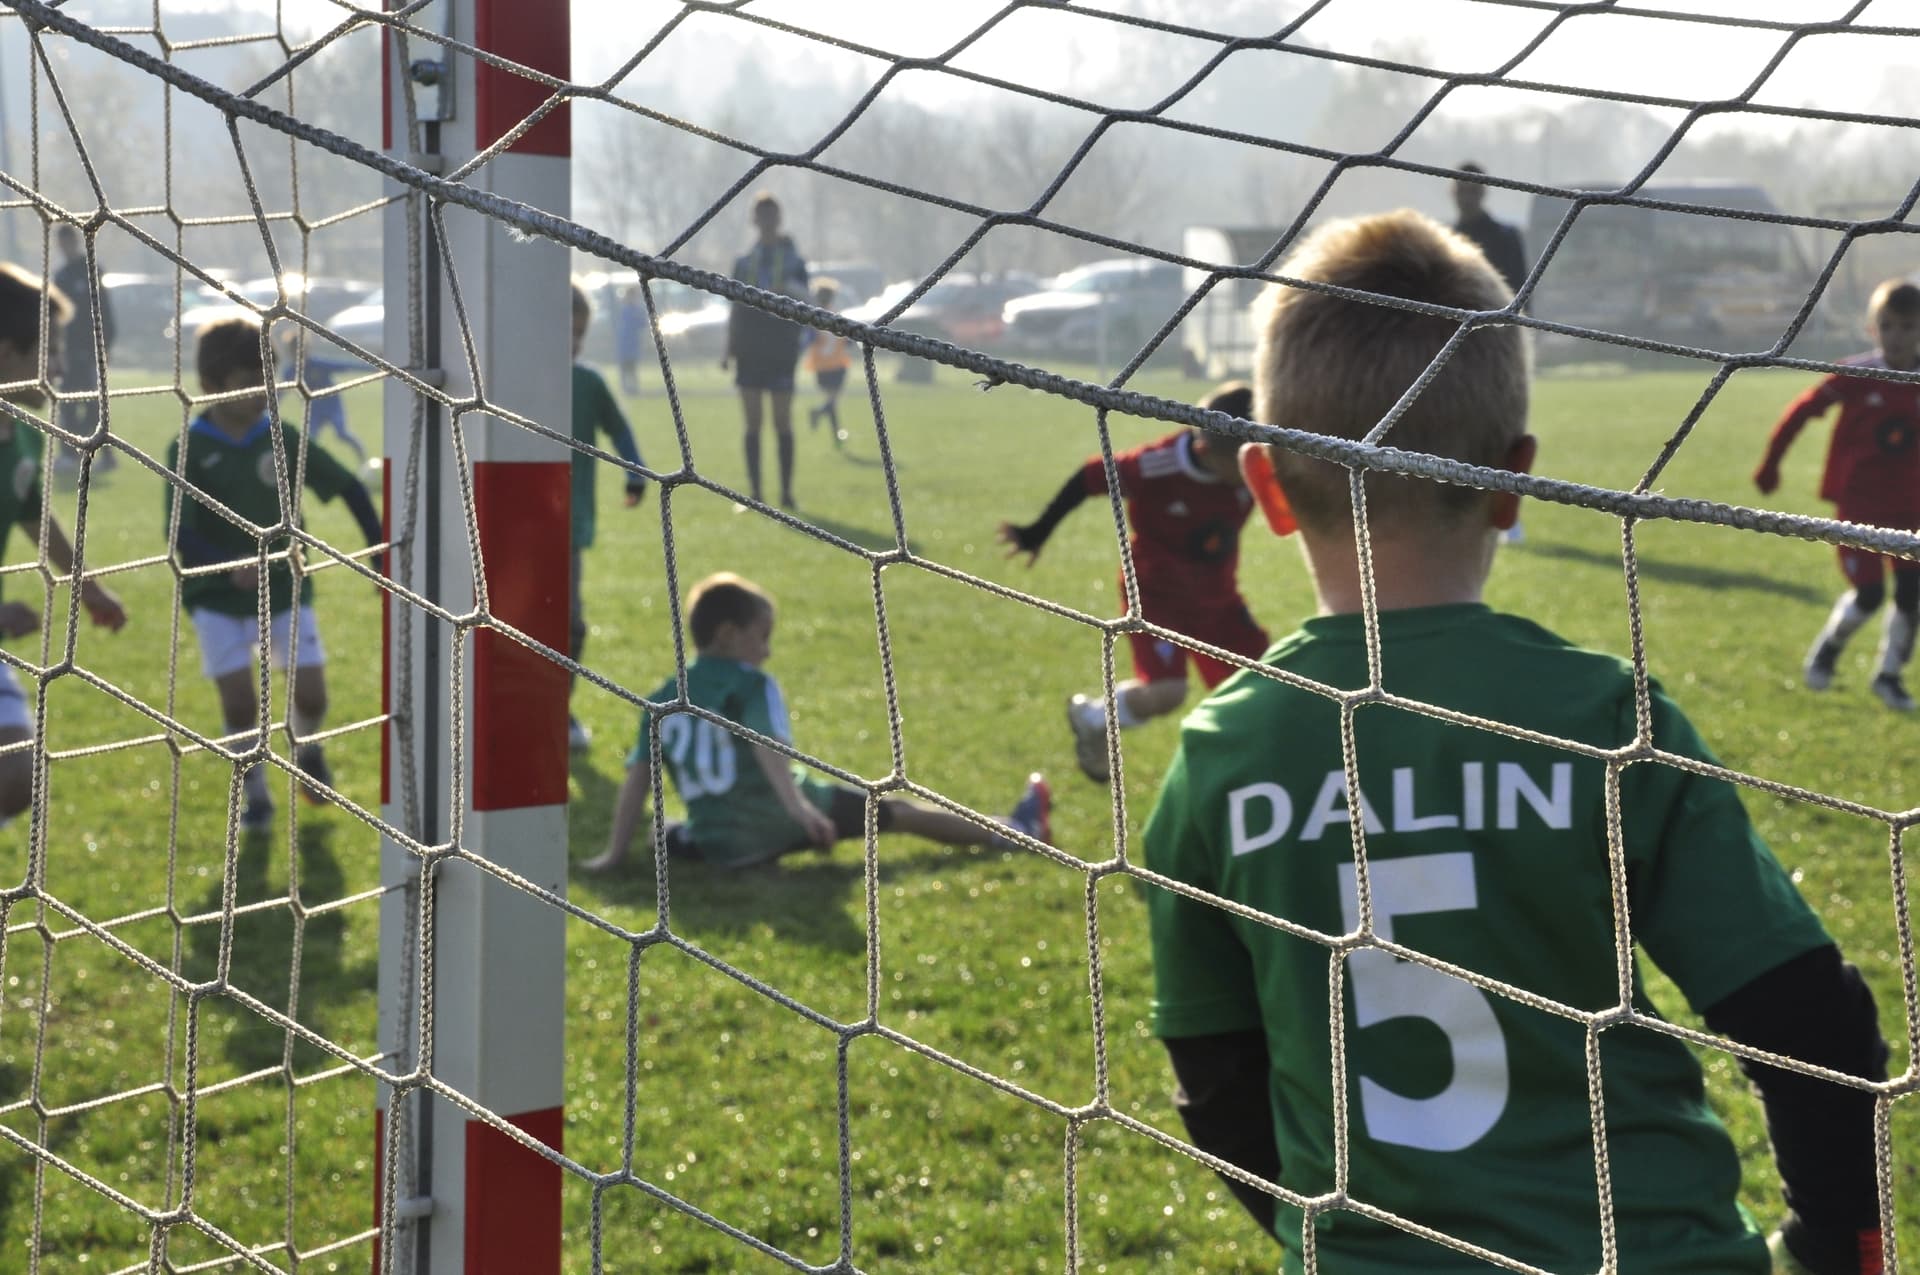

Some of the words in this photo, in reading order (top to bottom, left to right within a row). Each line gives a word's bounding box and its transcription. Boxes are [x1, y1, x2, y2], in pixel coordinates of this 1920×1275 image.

[659, 711, 737, 800] 20
[1228, 762, 1572, 857] DALIN
[1337, 852, 1510, 1152] 5
